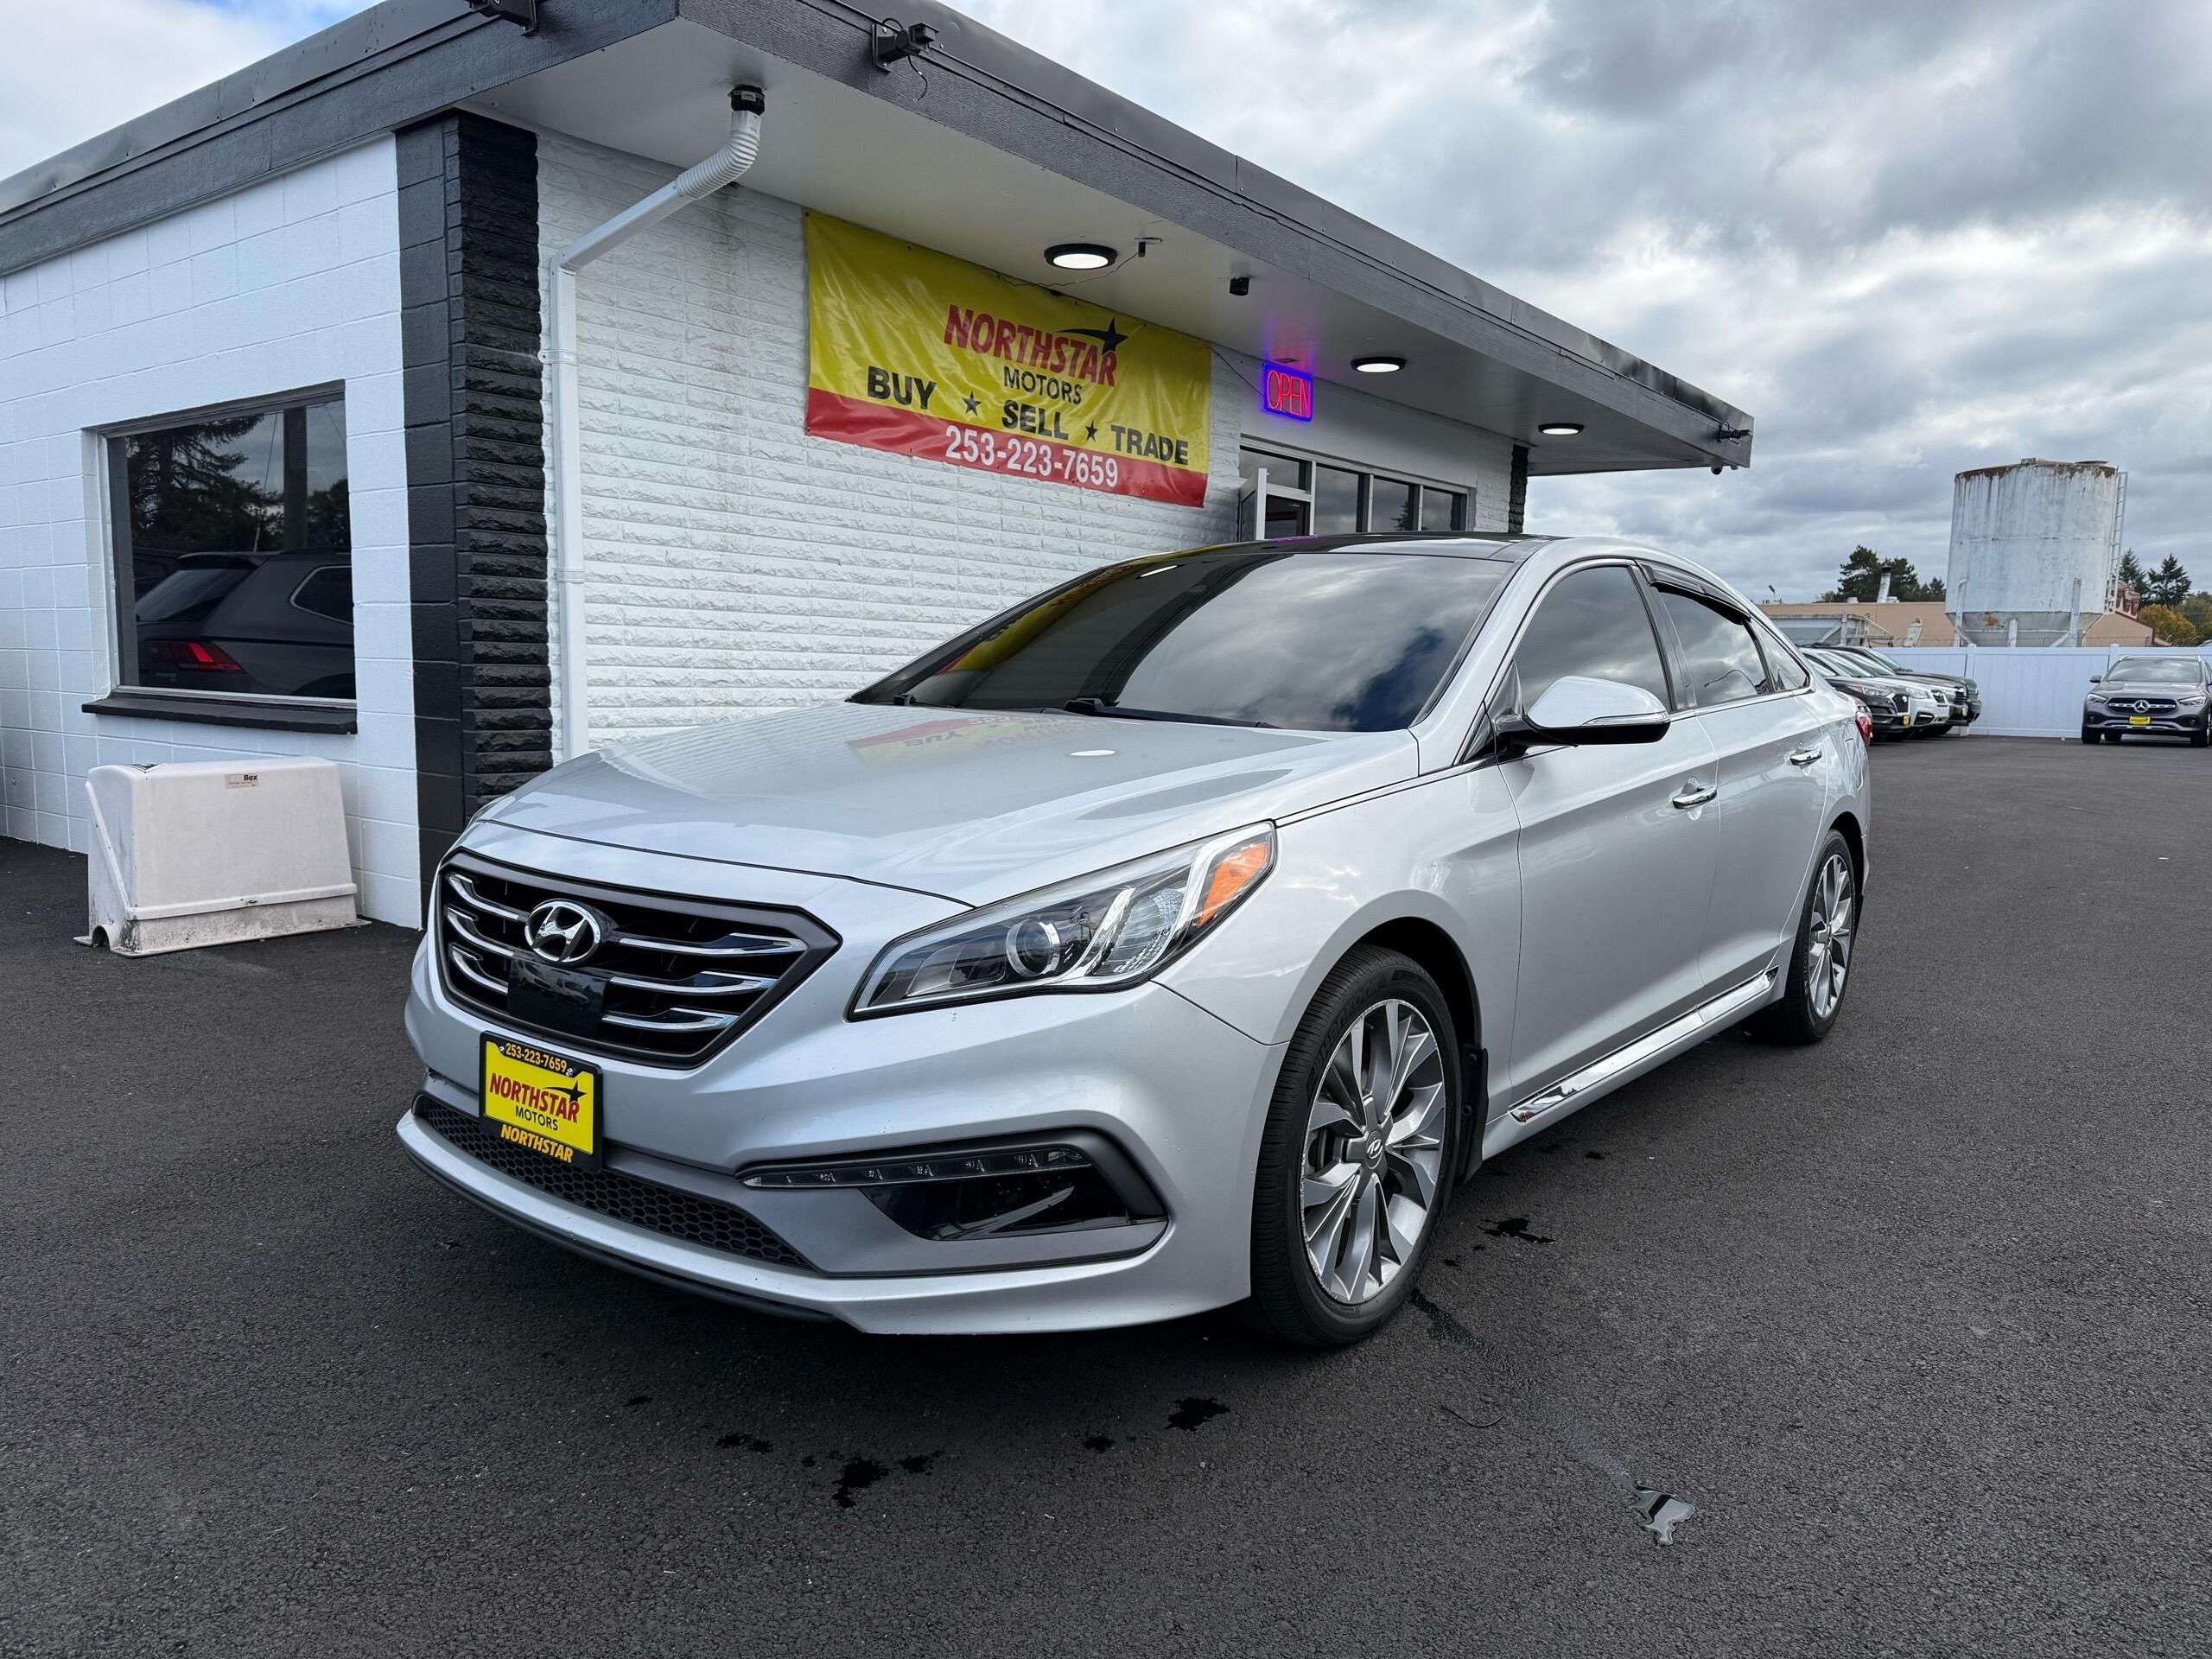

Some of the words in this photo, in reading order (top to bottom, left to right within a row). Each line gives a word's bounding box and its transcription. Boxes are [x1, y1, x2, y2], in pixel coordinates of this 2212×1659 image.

[944, 304, 1117, 387] NORTHSTAR
[1004, 366, 1083, 404] MOTORS
[1267, 369, 1311, 418] OPEN
[868, 365, 937, 410] BUY
[1001, 399, 1069, 441] SELL
[1110, 424, 1189, 465] TRADE
[945, 425, 1119, 487] 253-223-7659
[505, 1043, 568, 1072] 253-223-7659
[489, 1073, 580, 1123] NORTHSTAR
[515, 1105, 558, 1131] MOTORS
[500, 1124, 574, 1163] NORTHSTAR
